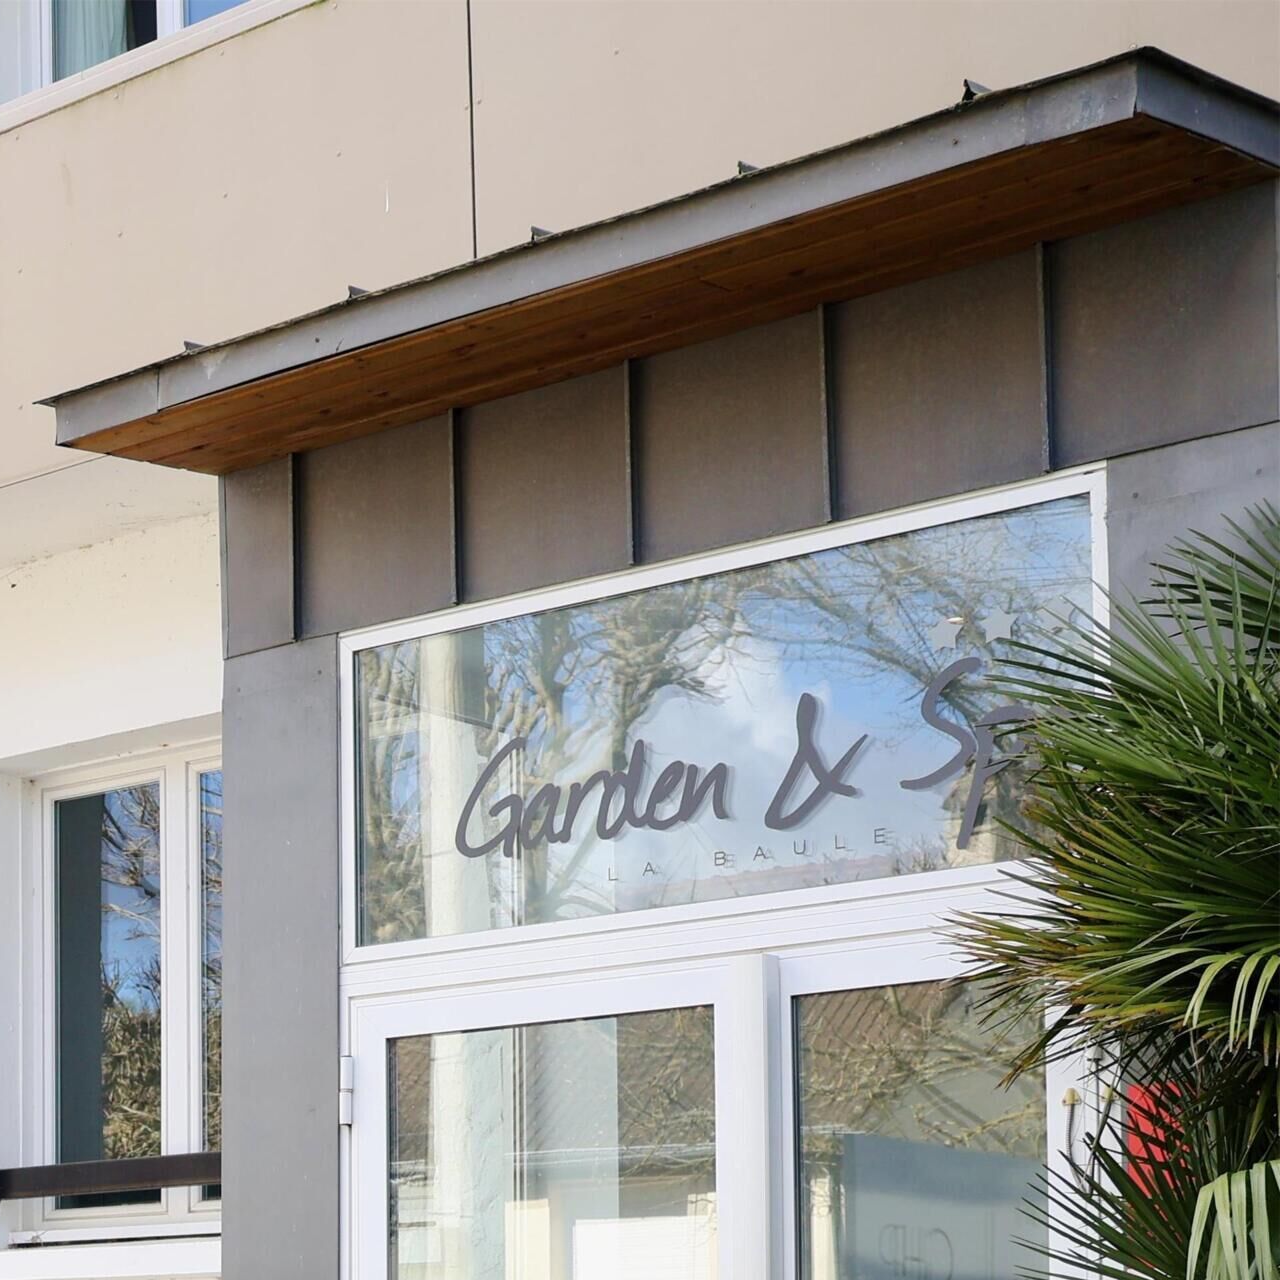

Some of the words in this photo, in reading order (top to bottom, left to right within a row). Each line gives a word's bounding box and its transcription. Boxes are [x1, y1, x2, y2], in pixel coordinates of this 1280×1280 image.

[456, 739, 730, 857] Garden
[765, 693, 869, 829] &
[900, 657, 1070, 849] Sp
[607, 861, 656, 881] LA
[714, 828, 887, 866] BAULE
